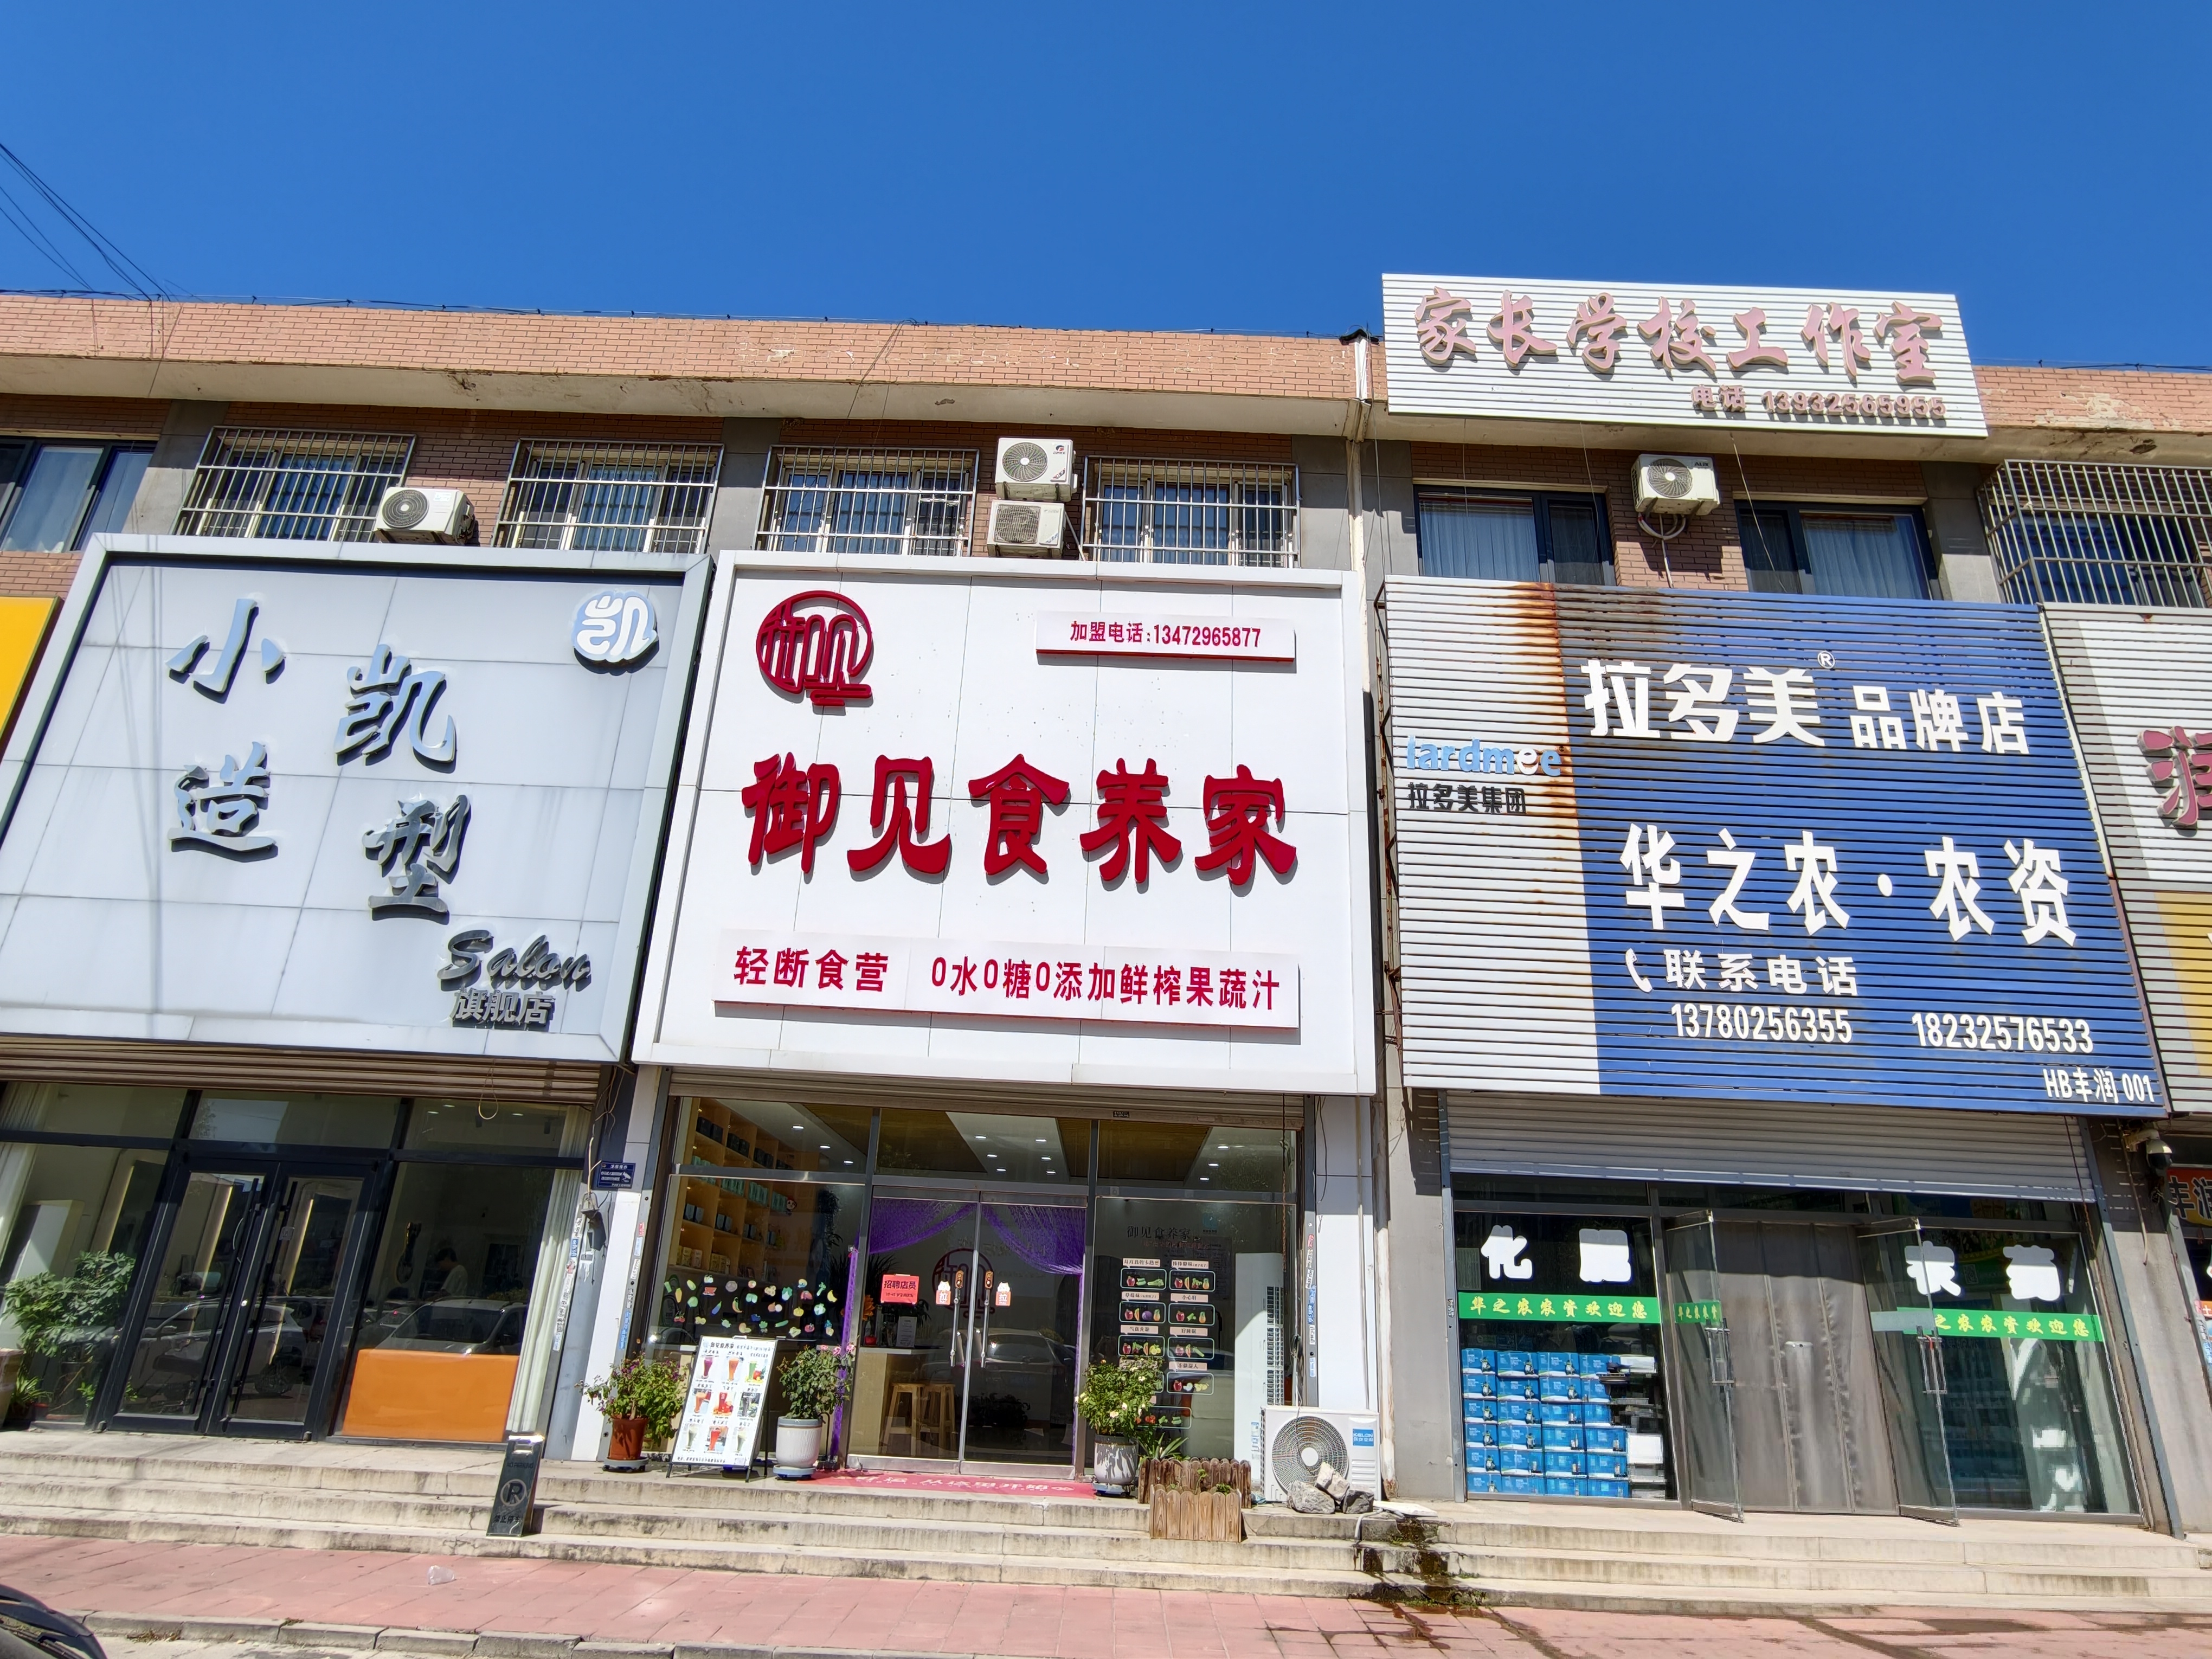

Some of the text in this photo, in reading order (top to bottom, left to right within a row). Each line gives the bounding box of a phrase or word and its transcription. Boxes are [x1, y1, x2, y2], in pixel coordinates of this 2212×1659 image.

[1416, 286, 1943, 384] 家长学校工作室
[1691, 385, 1947, 419] 电话 13932565955
[1070, 621, 1261, 647] 加盟电话:13472965877
[1581, 660, 1826, 747] 拉多美
[1850, 685, 2030, 754] 品牌店
[742, 753, 1296, 886] 御见食养家
[1408, 782, 1527, 814] 拉多美集团
[437, 929, 592, 981] Salon
[735, 946, 1280, 1010] 轻断食营 0水0糖0添加鲜榨果蔬汁
[1666, 949, 1858, 996] 联系电话
[450, 989, 554, 1025] 旗舰店
[1671, 1003, 2094, 1054] 13780256355 18232576533
[883, 1280, 917, 1290] 招聘店员
